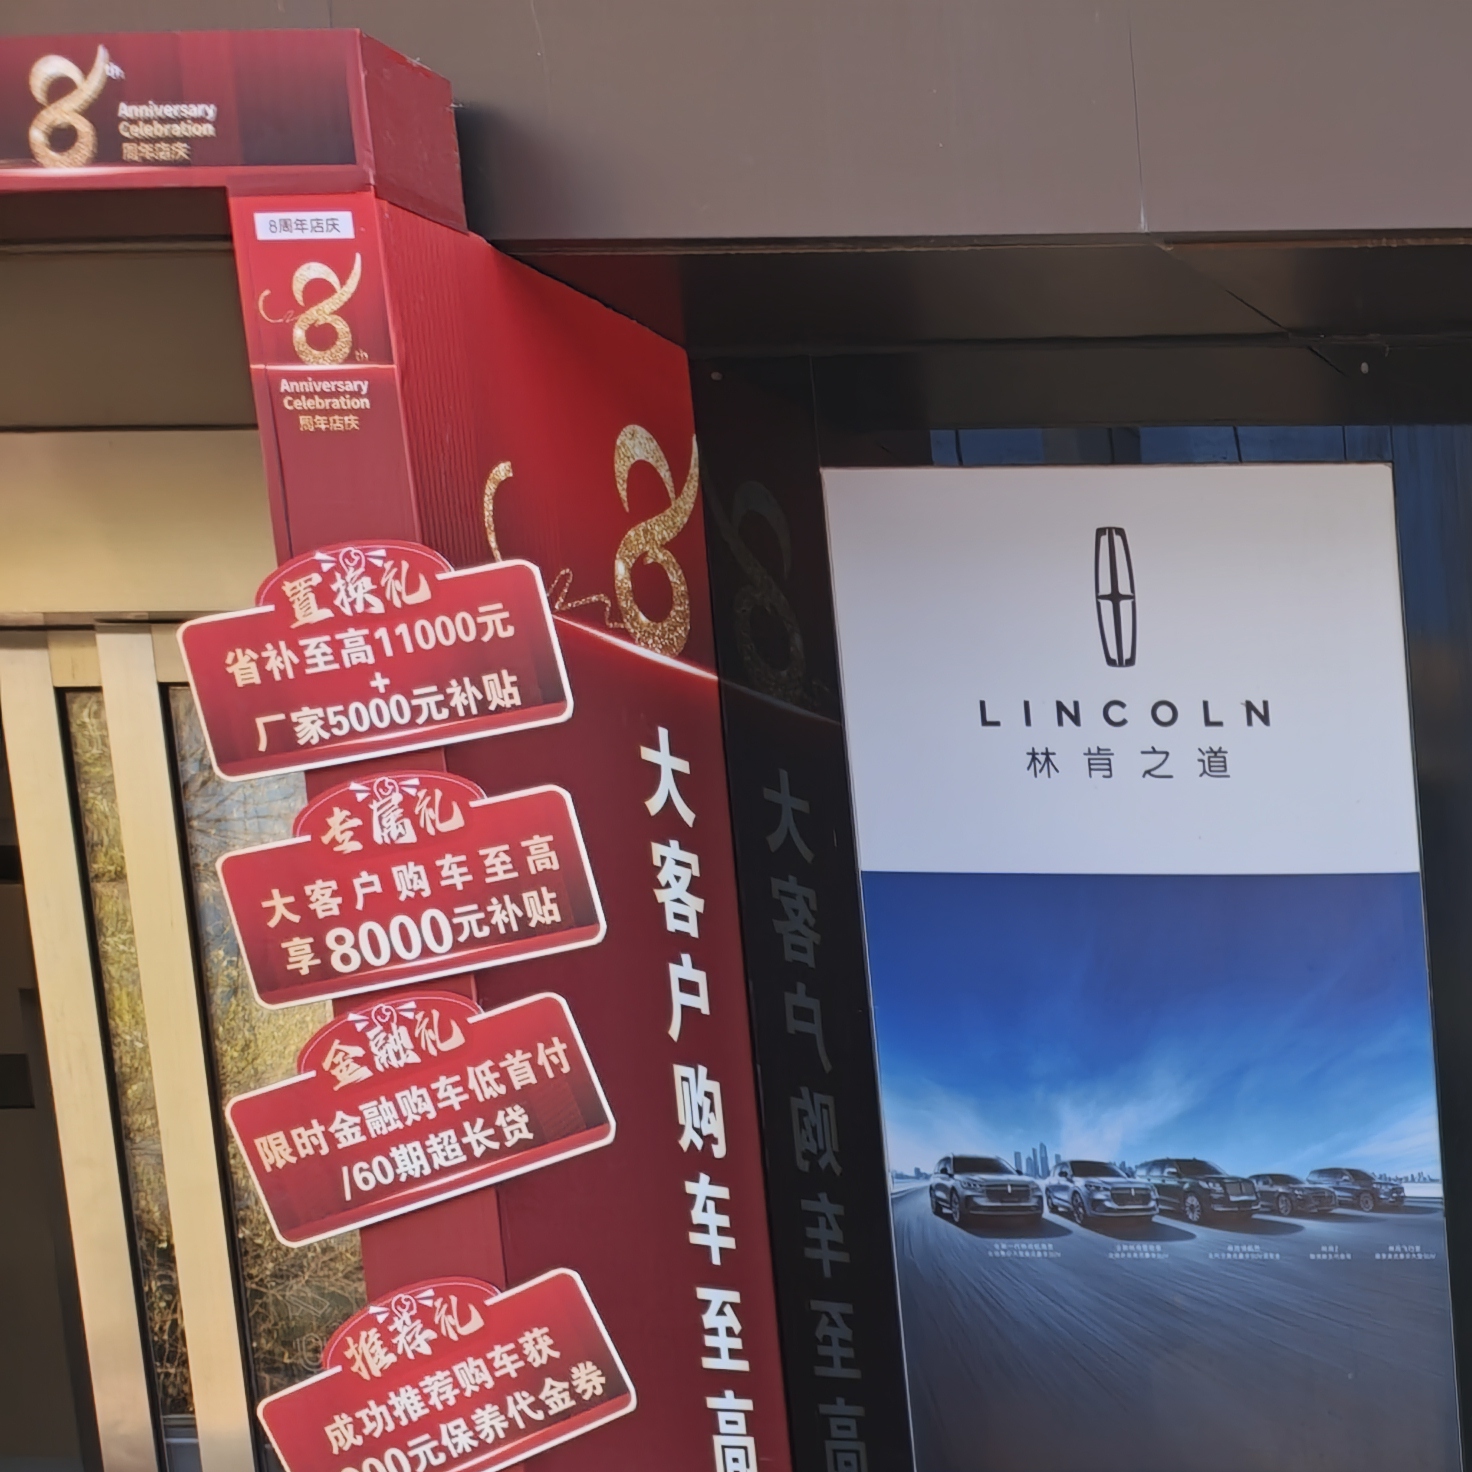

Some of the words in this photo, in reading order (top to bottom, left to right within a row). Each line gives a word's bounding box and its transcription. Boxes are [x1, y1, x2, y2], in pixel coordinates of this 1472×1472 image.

[117, 101, 217, 120] Anniversary
[118, 121, 216, 138] Celebration
[269, 218, 341, 234] 8周年店庆
[280, 378, 368, 395] Anniversary
[283, 396, 371, 411] Celebration
[299, 415, 360, 432] 周年店庆
[286, 559, 432, 629] 置换礼
[224, 603, 515, 689] 省补至高11000元
[254, 672, 521, 752] 厂家5000元补贴
[979, 700, 1271, 727] LINCOLN
[1026, 746, 1231, 780] 林肯之道
[322, 789, 465, 854] 专属礼
[261, 834, 561, 930] 大客户购车至高
[280, 888, 561, 976] 享8000元补贴
[320, 1009, 466, 1091] 金融礼
[255, 1039, 570, 1173] 限时金融购车低首付
[339, 1105, 534, 1199] /60期超长贷
[345, 1295, 485, 1381] 推荐礼
[325, 1327, 561, 1455] 成功推荐购车获
